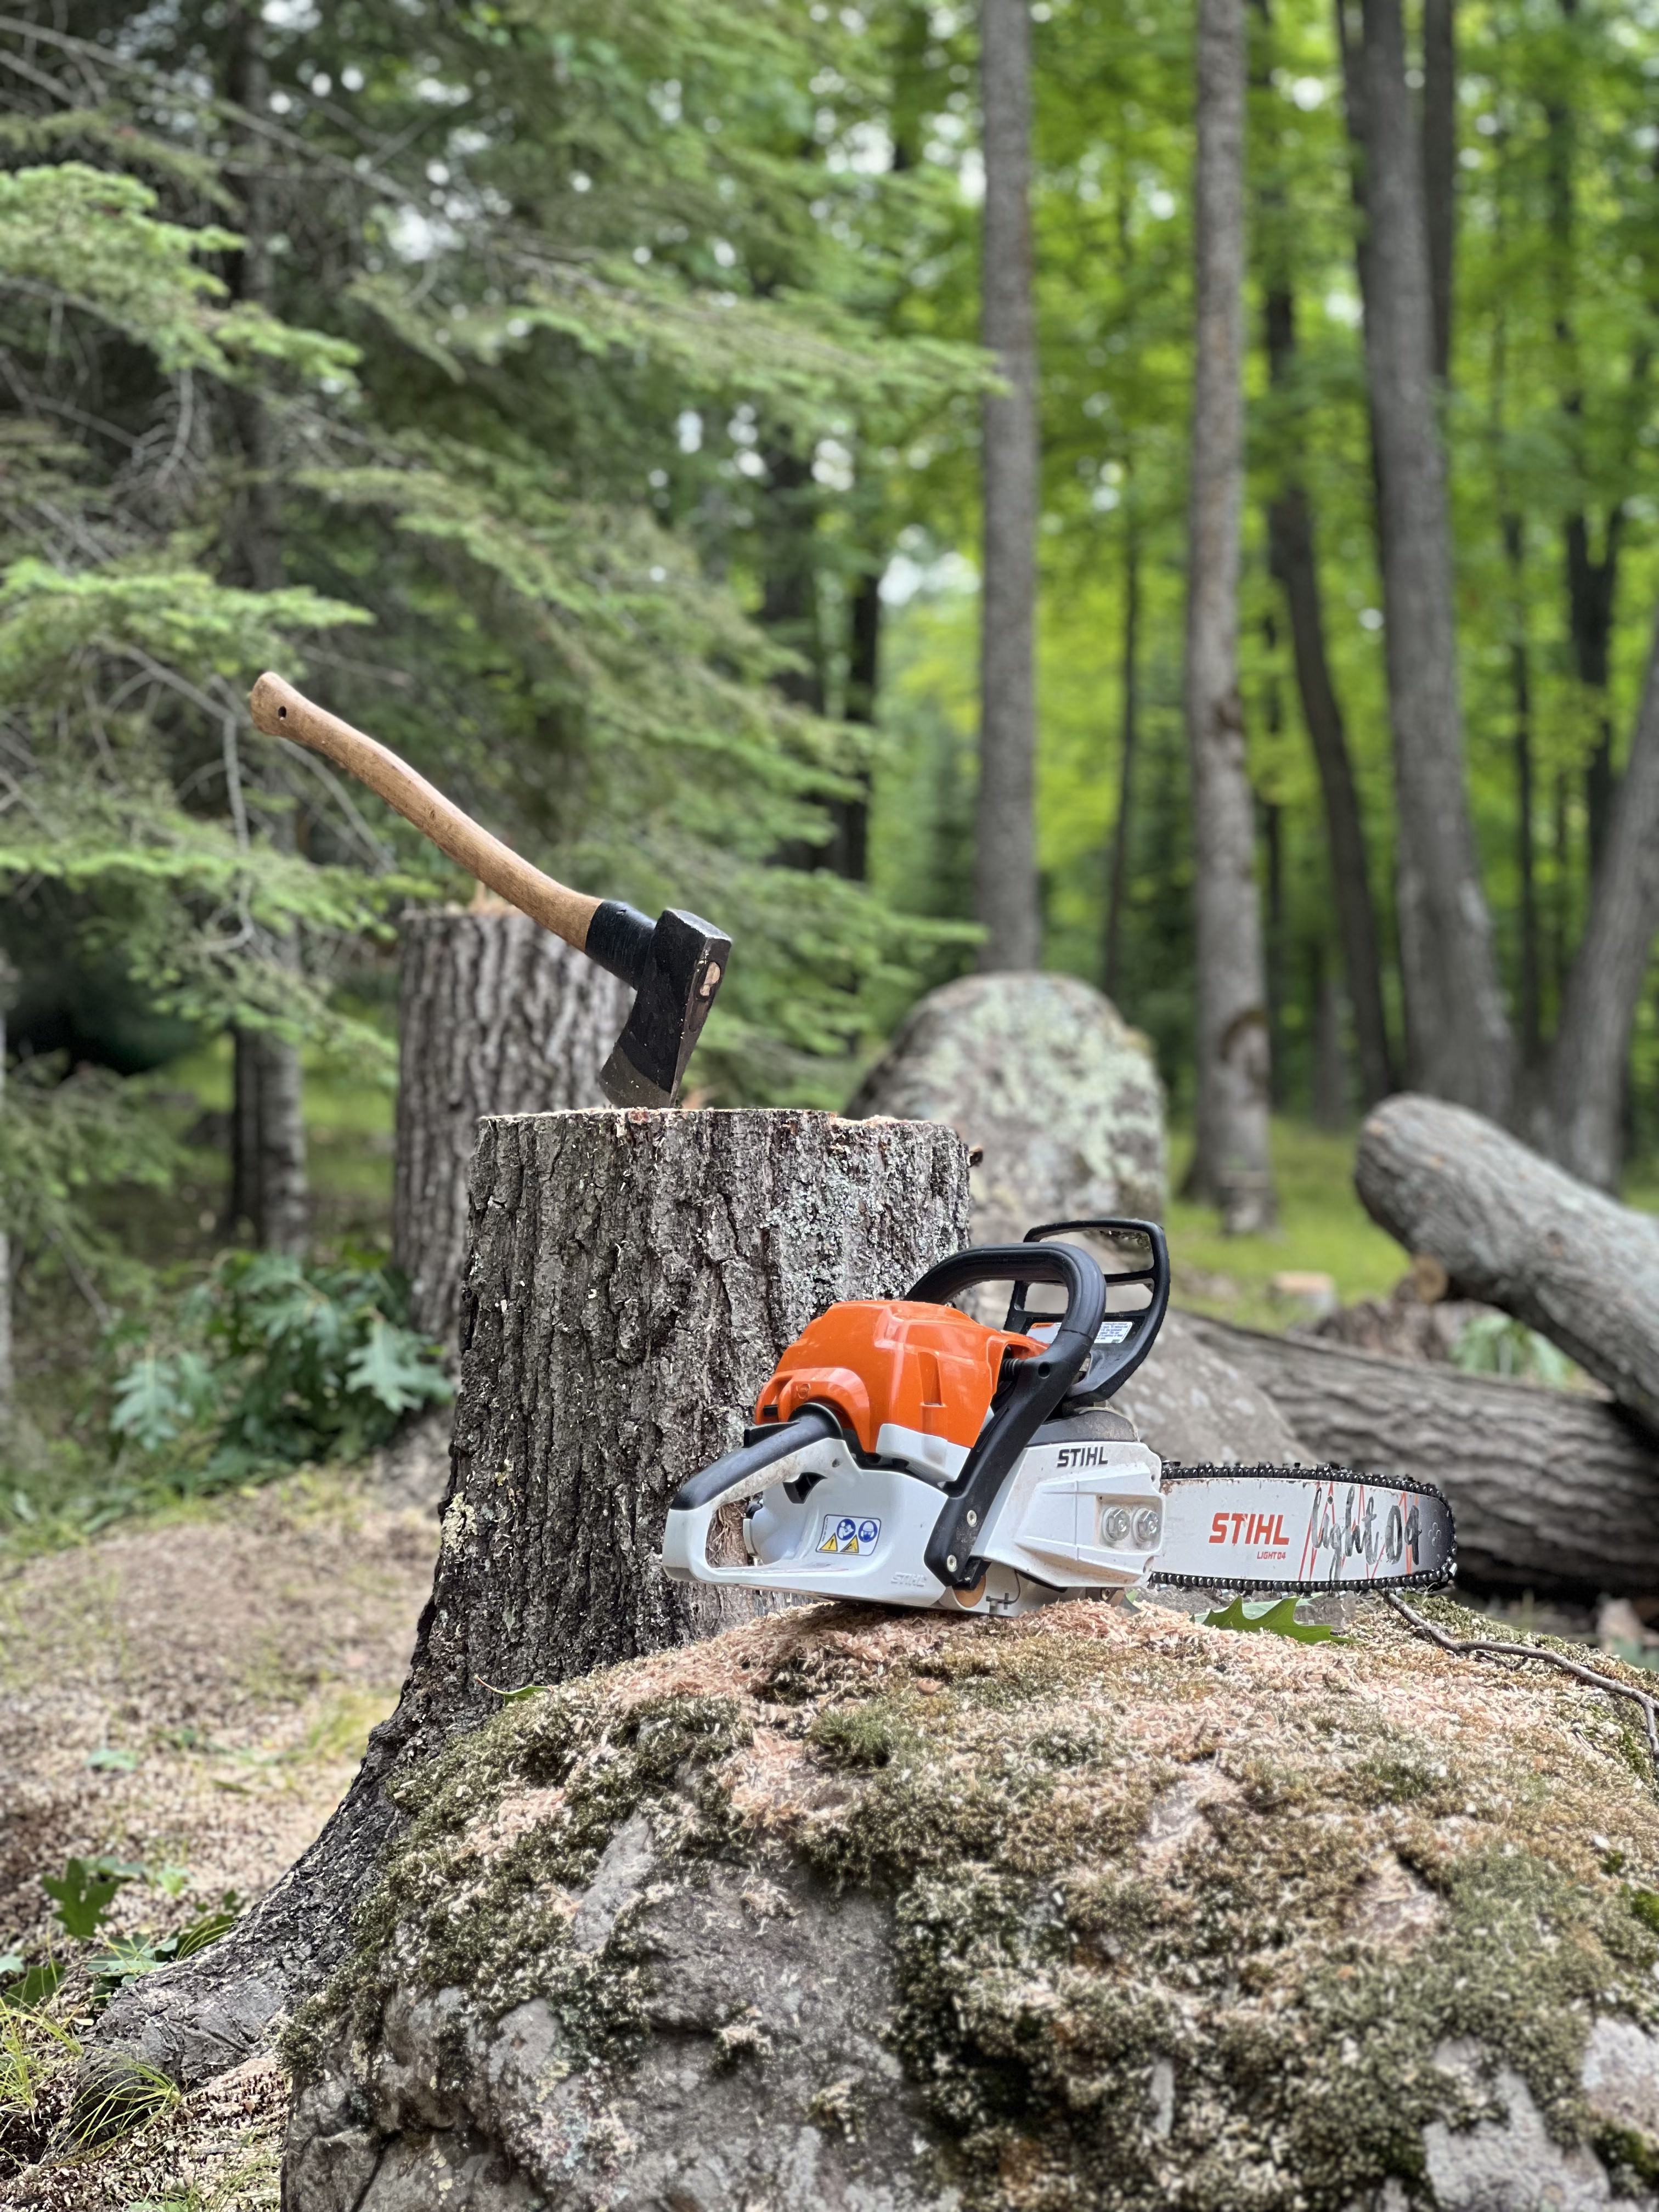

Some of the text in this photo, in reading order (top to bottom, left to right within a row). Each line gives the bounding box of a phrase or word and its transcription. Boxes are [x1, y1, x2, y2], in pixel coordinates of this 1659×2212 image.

[1057, 1446, 1108, 1467] STIHL
[1209, 1513, 1290, 1545] STIHL
[890, 1572, 927, 1587] STIHL
